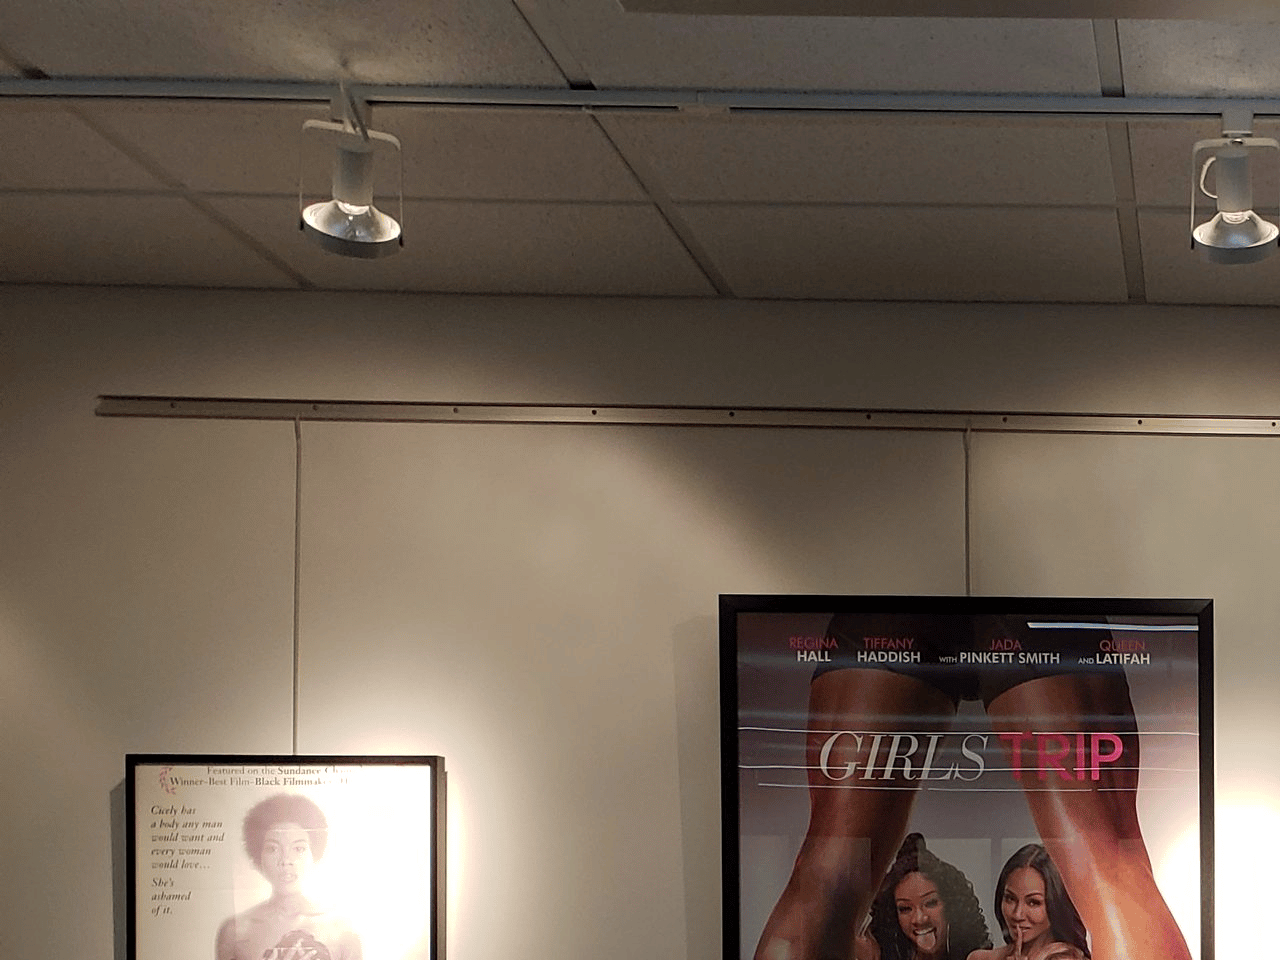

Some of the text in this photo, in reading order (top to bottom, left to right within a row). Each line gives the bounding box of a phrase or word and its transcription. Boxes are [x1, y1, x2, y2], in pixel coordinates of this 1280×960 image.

[789, 636, 839, 649] REGINA
[863, 637, 914, 650] TIFFANY
[989, 639, 1022, 650] JADA
[1100, 639, 1146, 651] QUEEN
[797, 650, 832, 662] HALL
[857, 651, 921, 663] HADDISH
[960, 652, 1014, 664] PINKETT
[1018, 652, 1060, 664] SMITH
[1078, 653, 1151, 665] AND LATIFAH
[819, 731, 1124, 782] GIRLS TRIP
[181, 805, 196, 815] has
[150, 819, 223, 830] a body any man
[151, 832, 225, 842] would want and
[151, 848, 212, 857] every woman
[151, 859, 179, 869] would
[151, 877, 174, 888] She's
[151, 890, 192, 901] ashamed
[151, 905, 173, 917] of it.
